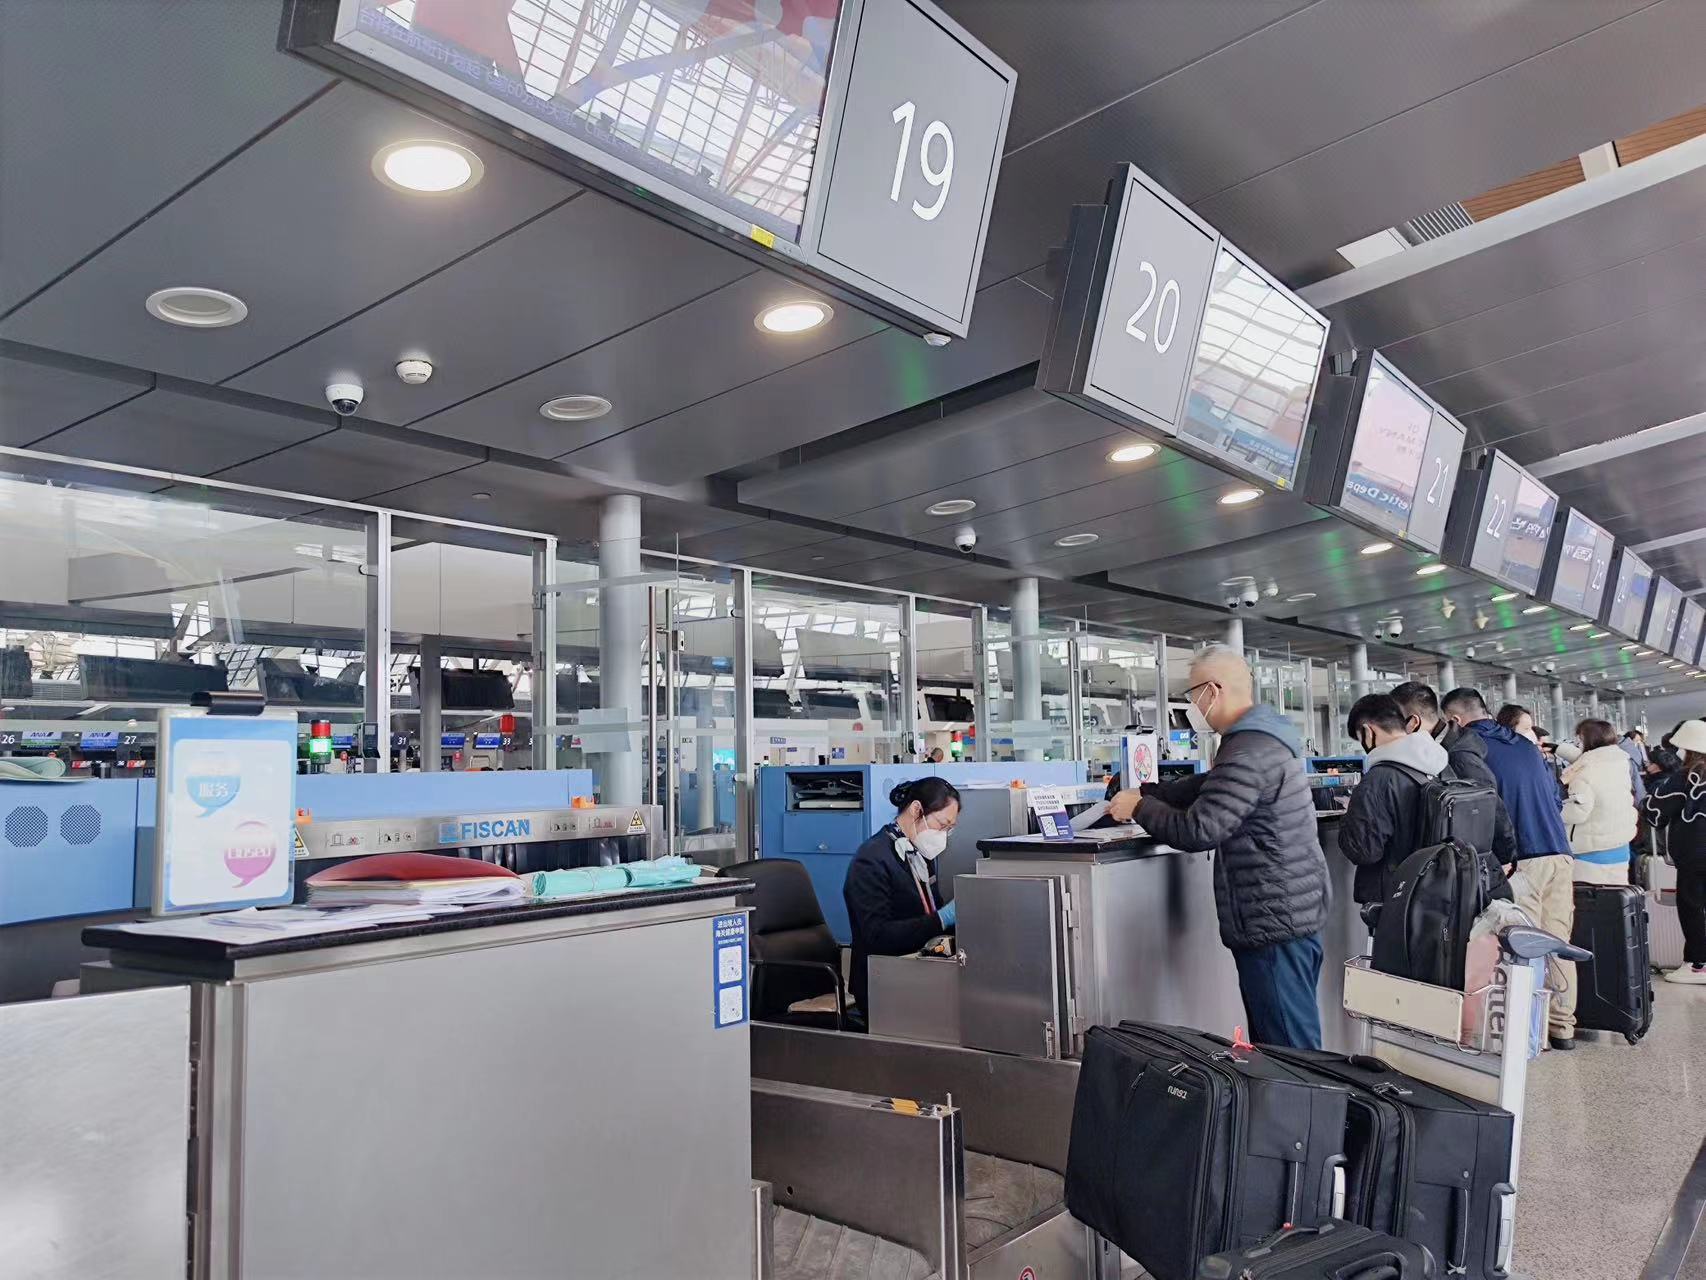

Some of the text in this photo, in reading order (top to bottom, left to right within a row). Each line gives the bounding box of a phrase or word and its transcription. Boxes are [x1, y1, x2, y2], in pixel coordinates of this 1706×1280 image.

[890, 101, 954, 220] 19
[1126, 261, 1180, 353] 20
[1427, 457, 1449, 508] 21
[1486, 494, 1507, 538] 22
[1, 734, 15, 744] 26
[123, 735, 136, 745] 27
[397, 737, 407, 745] 31
[461, 819, 530, 839] FISCAN
